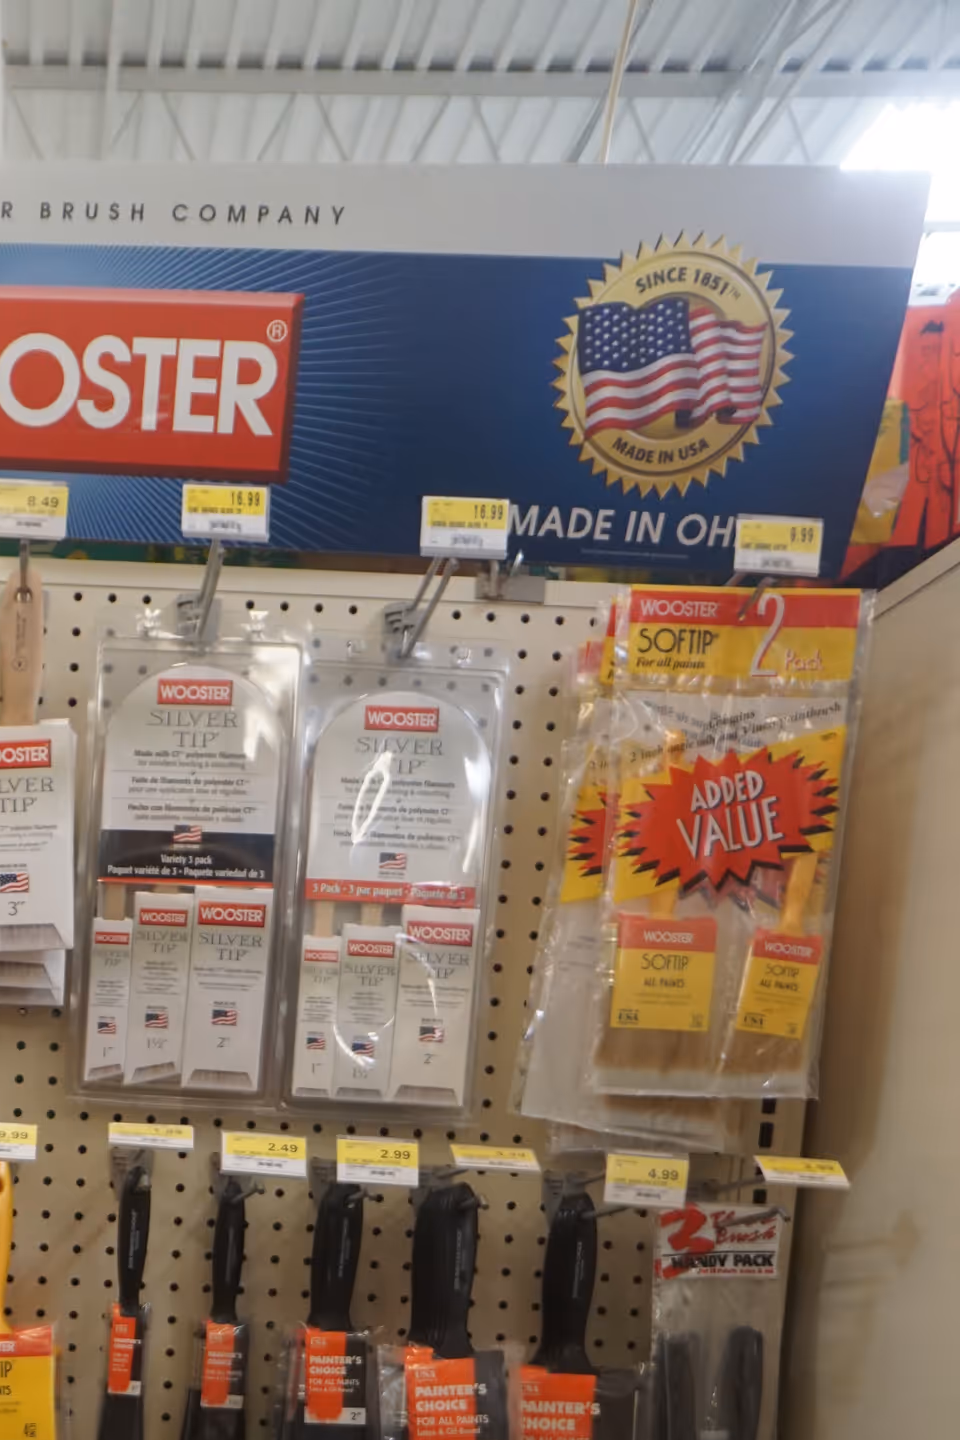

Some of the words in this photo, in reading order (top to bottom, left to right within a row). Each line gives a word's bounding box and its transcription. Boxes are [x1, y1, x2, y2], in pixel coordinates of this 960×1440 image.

[39, 202, 145, 220] BRUSH
[171, 203, 346, 226] COMPANY
[636, 266, 688, 293] SINCE
[693, 268, 730, 296] 1851
[611, 437, 654, 464] MADE
[658, 447, 675, 464] IN
[678, 438, 710, 461] USA
[508, 505, 615, 540] MADE
[624, 511, 666, 544] IN
[639, 598, 717, 618] WOOSTER
[637, 627, 714, 655] SOFTIP
[751, 592, 786, 678] 2
[636, 657, 655, 668] For
[657, 657, 671, 668] all
[784, 648, 824, 671] Pack
[160, 685, 230, 701] WOOSTER
[147, 710, 238, 728] SILVER
[367, 711, 436, 727] WOOSTER
[172, 730, 220, 748] TIP
[690, 770, 765, 813] ADDED
[676, 796, 785, 859] VALUE
[200, 907, 264, 922] WOOSTER
[199, 932, 263, 948] SILVER
[409, 925, 471, 941] WOOSTER
[643, 930, 693, 945] WOOSTER
[215, 948, 249, 962] TIP
[764, 940, 815, 959] WOOSTER
[641, 953, 688, 972] SOFTIP
[268, 1142, 299, 1153] 2.49
[380, 1149, 411, 1160] 2.99
[671, 1254, 728, 1268] HANDY
[733, 1253, 774, 1267] PACK
[309, 1355, 362, 1365] PAINTER'S
[309, 1365, 346, 1375] CHOICE
[415, 1383, 487, 1397] PAINTER'S
[416, 1399, 467, 1412] CHOICE
[417, 1416, 436, 1426] FOR
[438, 1416, 455, 1426] ALL
[456, 1414, 489, 1425] PAINTS
